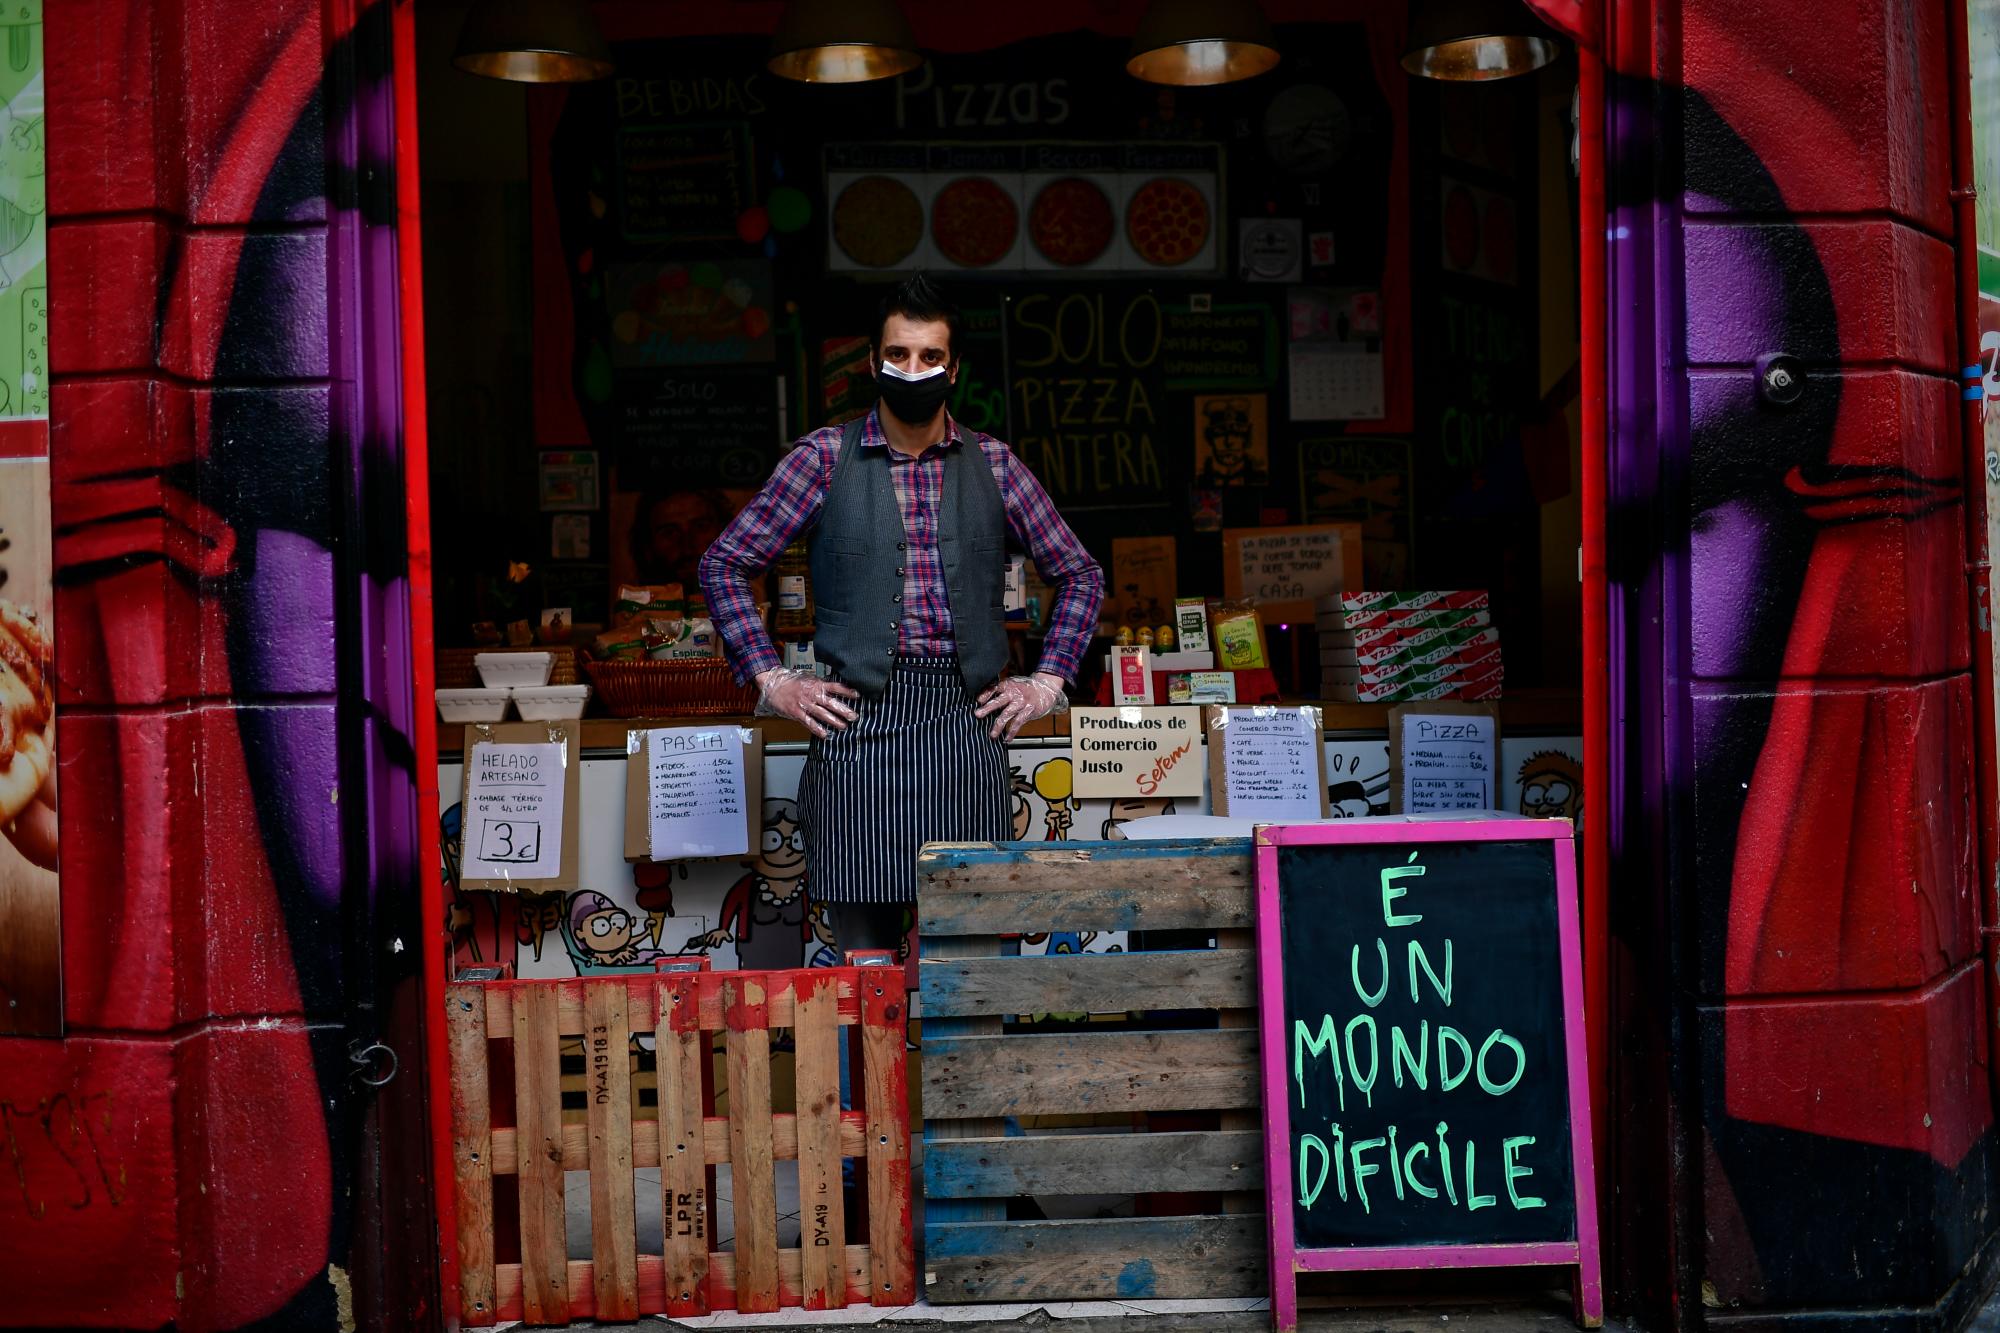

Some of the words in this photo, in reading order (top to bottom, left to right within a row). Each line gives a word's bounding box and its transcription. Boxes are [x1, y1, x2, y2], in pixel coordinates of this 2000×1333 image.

[615, 73, 768, 118] BEBIDAS
[895, 58, 1070, 128] Pizzas
[1015, 292, 1163, 368] SOLO
[1013, 377, 1157, 431] PIZZA
[1018, 431, 1164, 496] ENTERA
[1260, 583, 1305, 599] CASA
[672, 649, 713, 658] Espirales
[1080, 716, 1162, 729] Productos
[1168, 716, 1187, 729] de
[1269, 712, 1299, 722] SETEM
[1417, 721, 1480, 739] PIZZA
[661, 733, 723, 752] PASTA
[1080, 737, 1158, 751] Comercio
[1236, 738, 1252, 746] CAFÉ
[482, 753, 539, 769] HELADO
[660, 762, 686, 771] FIDEOS
[1080, 760, 1124, 774] Justo
[1136, 736, 1191, 796] Setem
[481, 771, 540, 782] ARTESANO
[1381, 850, 1427, 927] É
[1351, 936, 1453, 1008] UN
[1295, 1012, 1527, 1106] MONDO
[1298, 1120, 1548, 1214] DIFICILE
[677, 1193, 692, 1236] LPR
